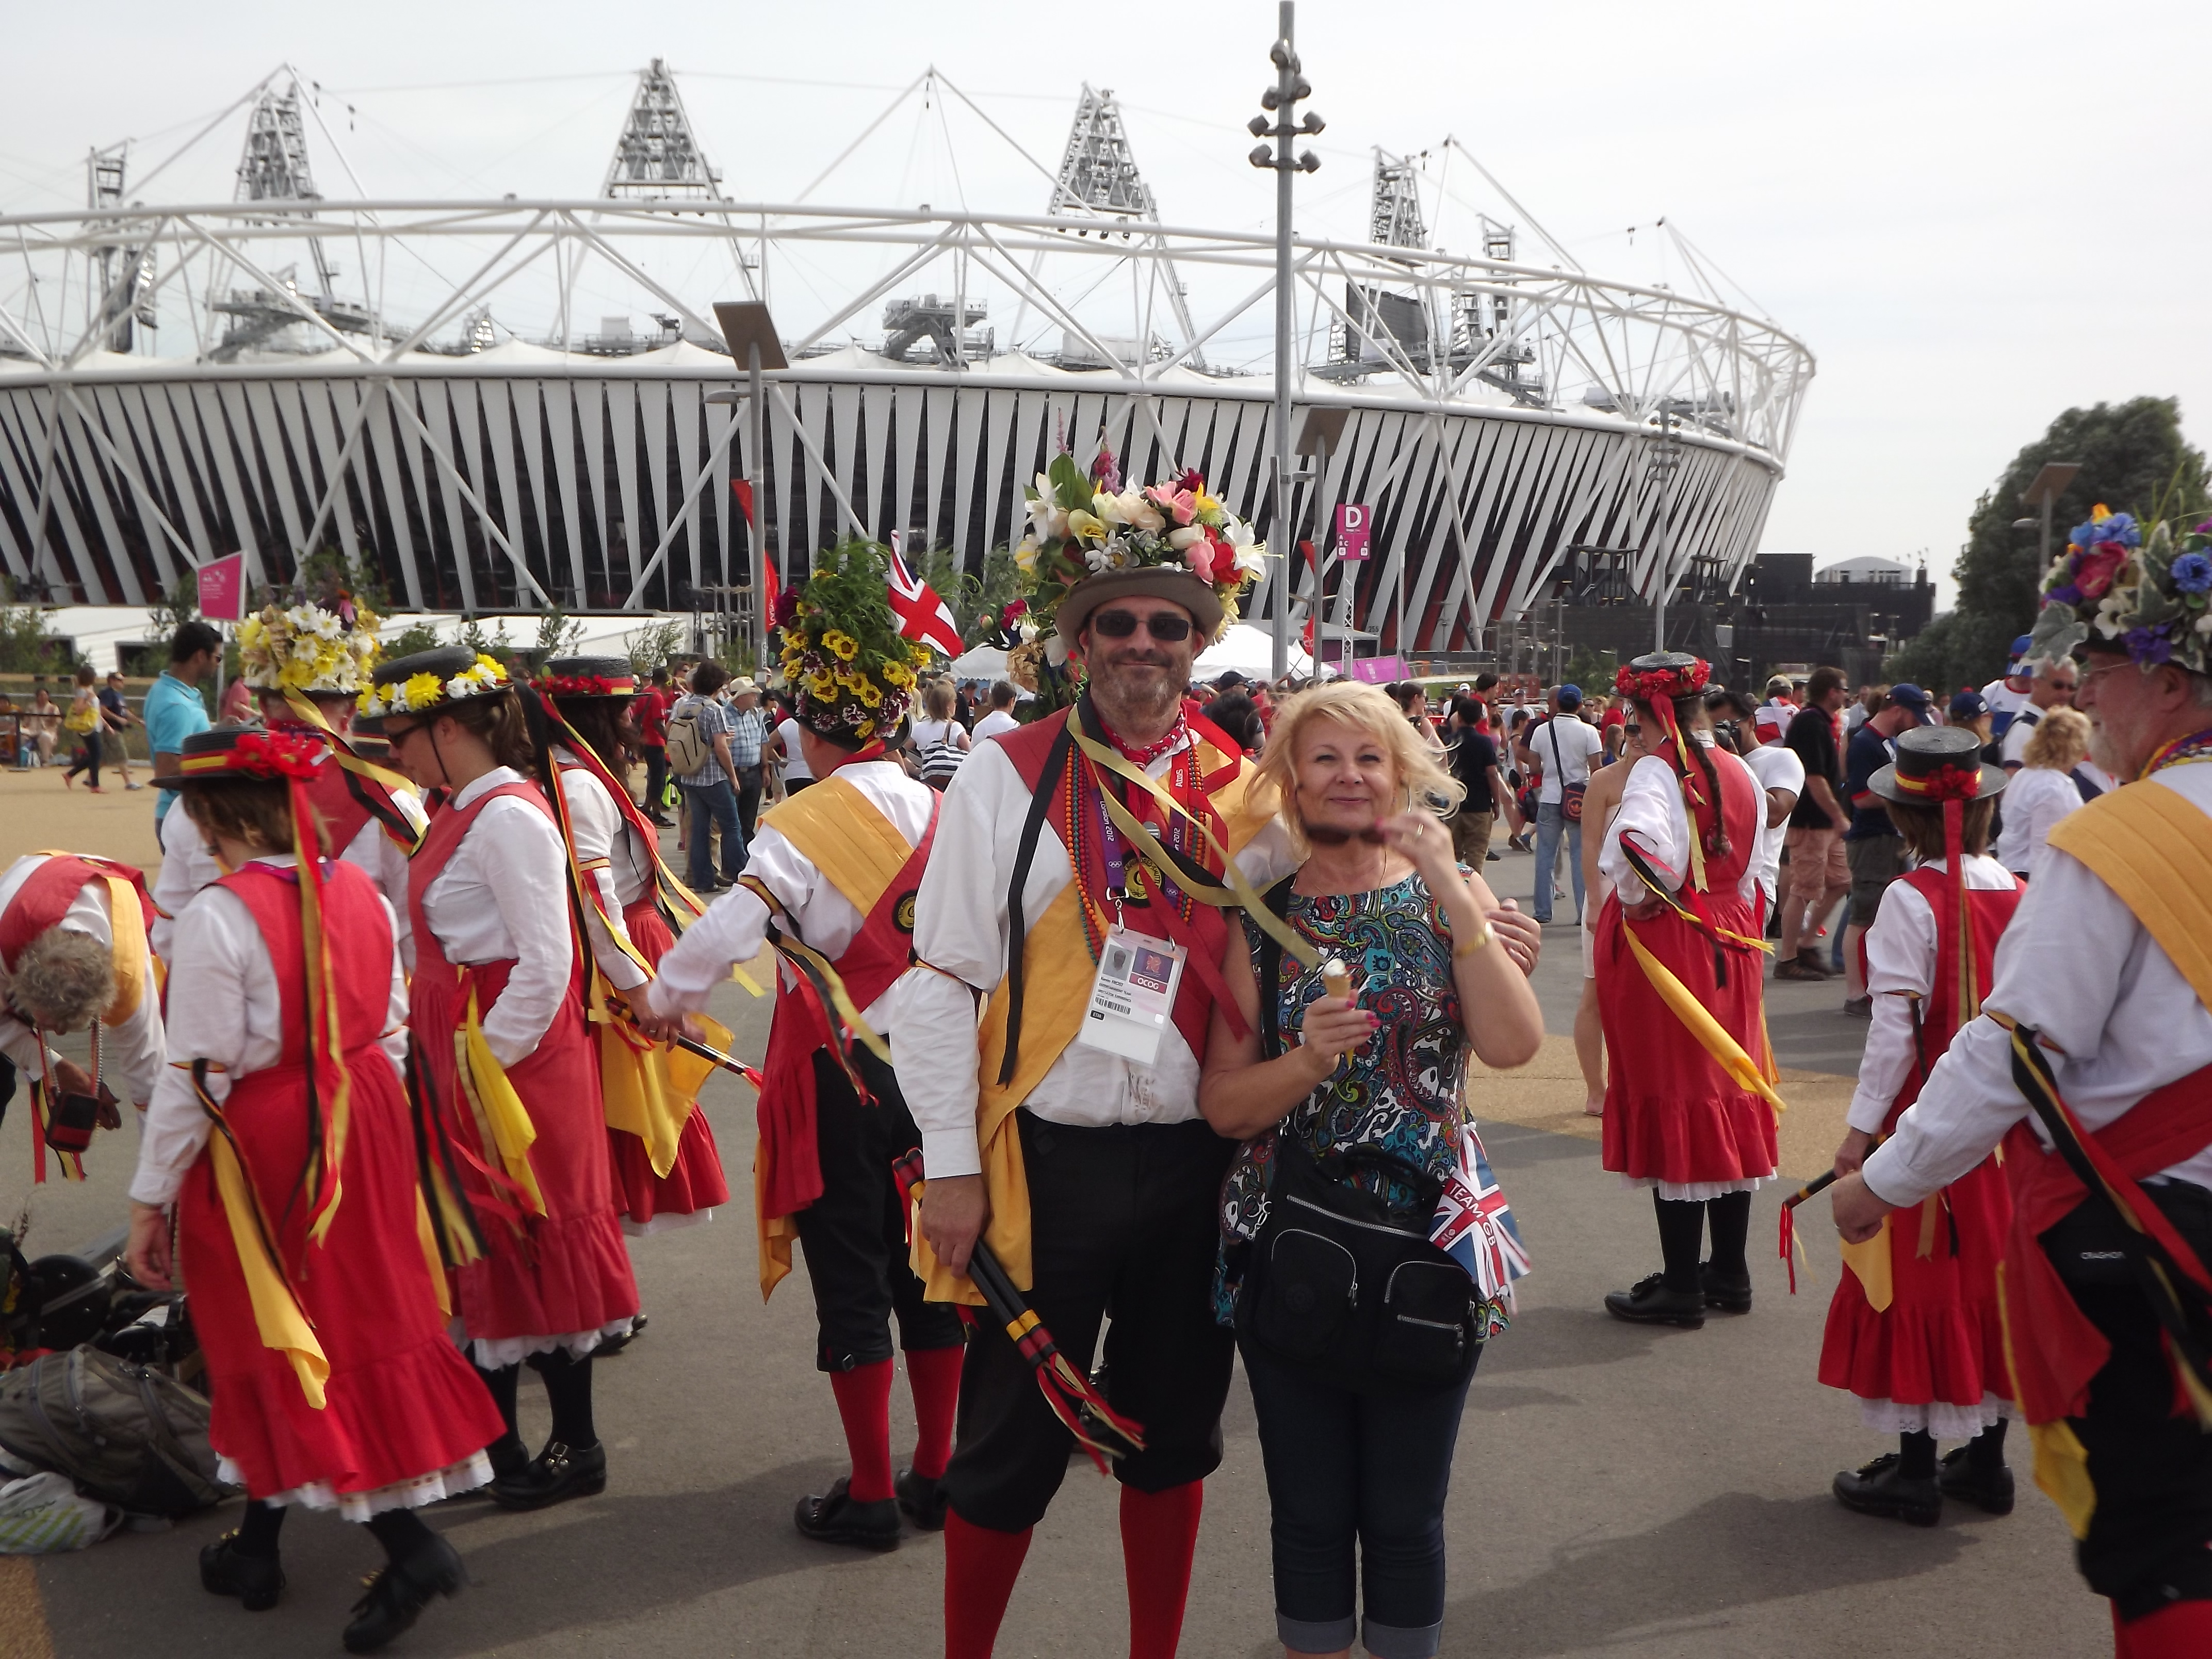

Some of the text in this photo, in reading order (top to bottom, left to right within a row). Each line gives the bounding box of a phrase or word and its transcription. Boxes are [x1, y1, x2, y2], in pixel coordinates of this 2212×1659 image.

[1346, 507, 1362, 527] D
[1105, 826, 1114, 841] 2012
[1137, 978, 1159, 989] OCOG
[1450, 1182, 1495, 1245] TEAM GB
